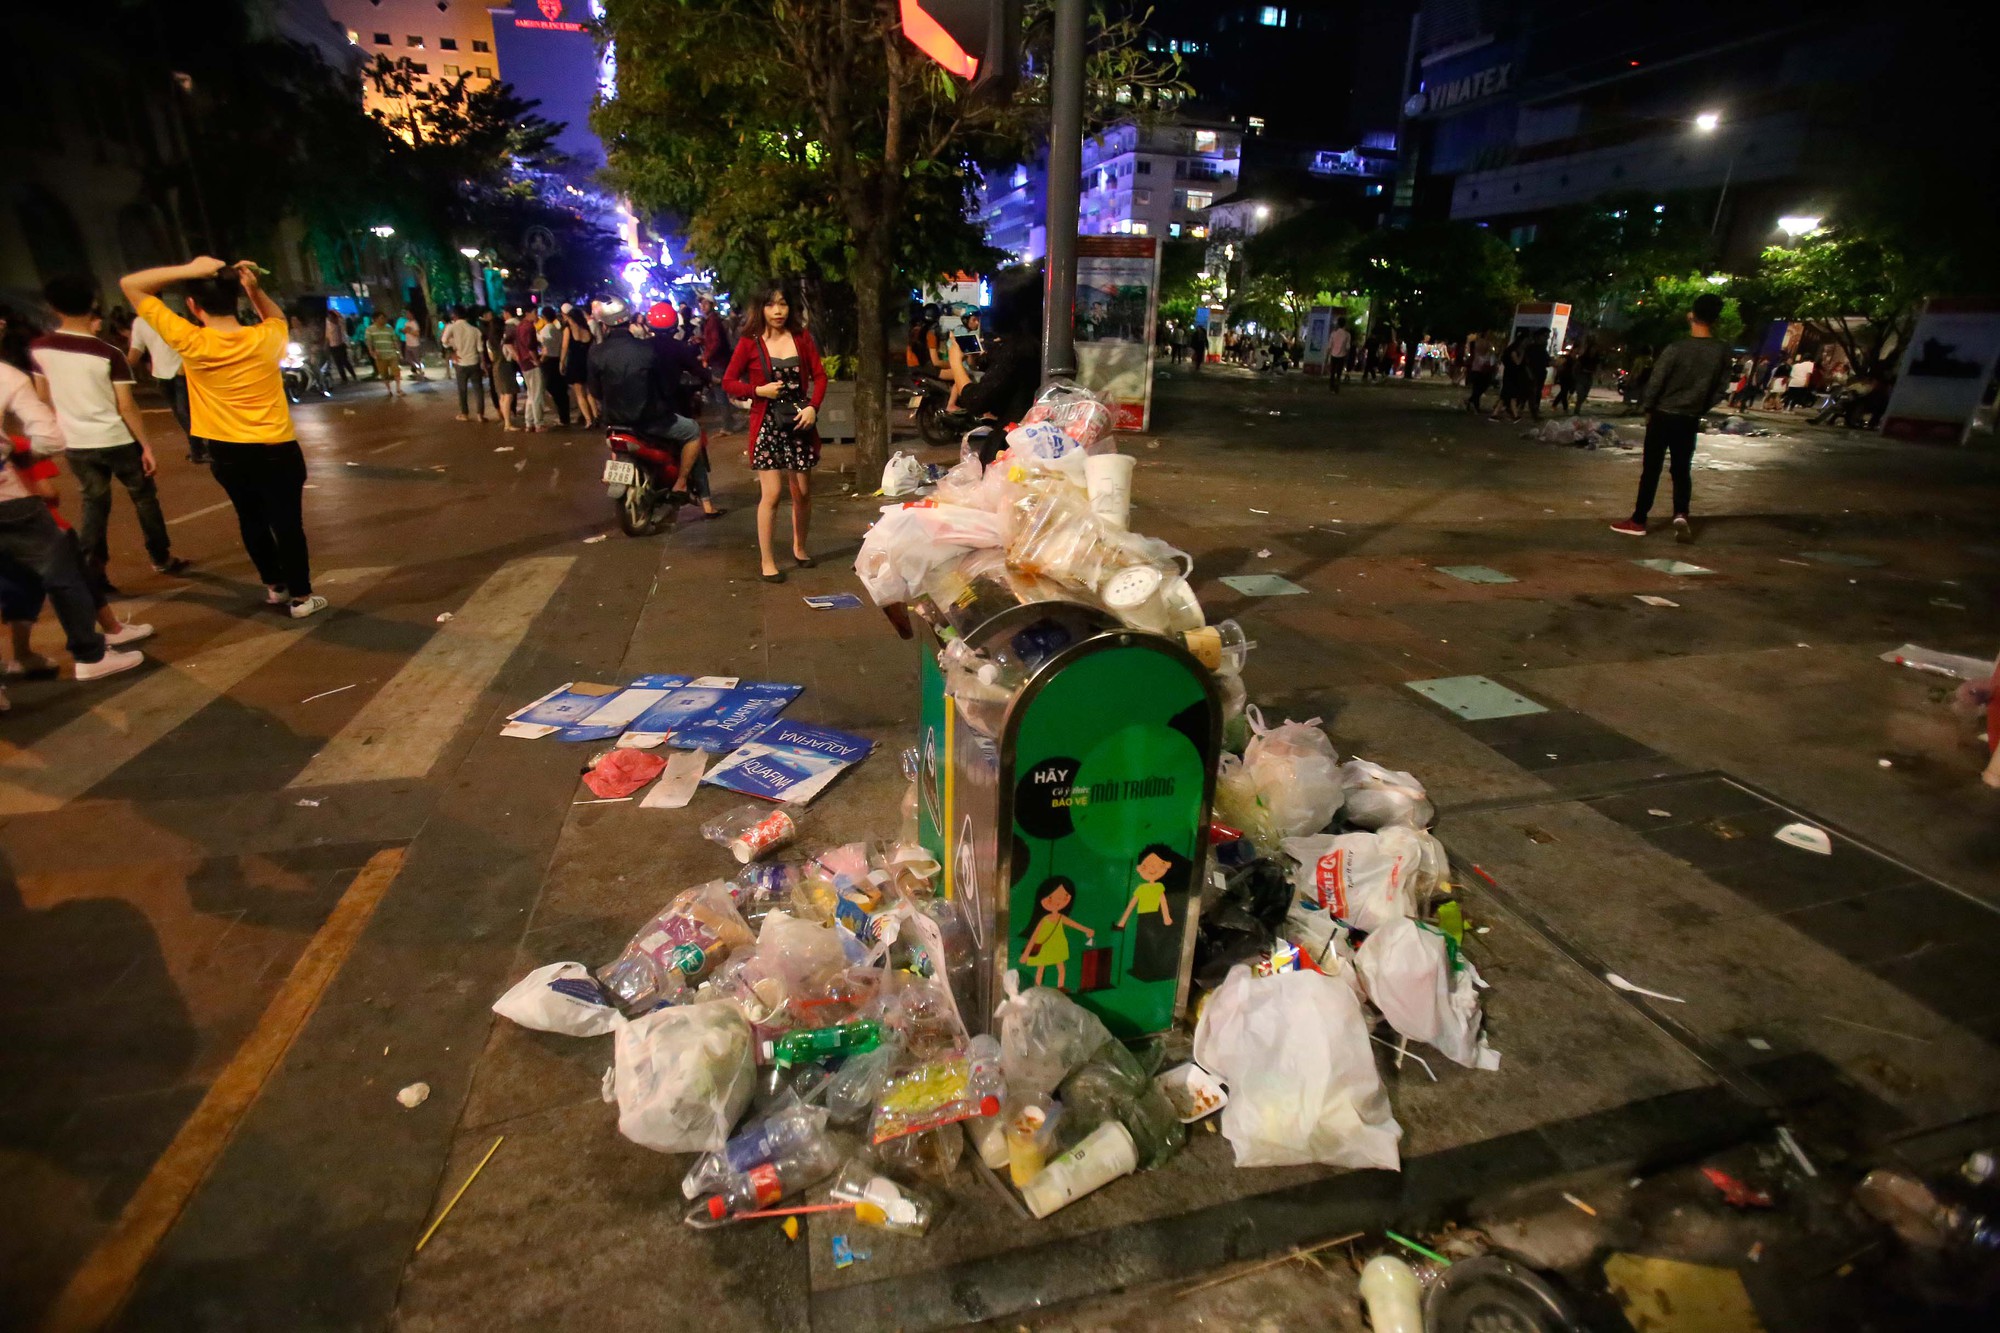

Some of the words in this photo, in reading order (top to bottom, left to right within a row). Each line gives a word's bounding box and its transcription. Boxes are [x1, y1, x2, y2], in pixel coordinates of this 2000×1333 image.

[1430, 62, 1512, 112] VINATEX
[717, 698, 769, 732] AQUAFINA
[778, 729, 858, 756] AQUAFINA
[738, 757, 794, 790] AQUAFINA
[1034, 767, 1069, 784] HÃY
[1091, 779, 1119, 803] MÔI
[1123, 775, 1176, 800] TRƯỜNG
[1324, 871, 1338, 913] CIRCLE
